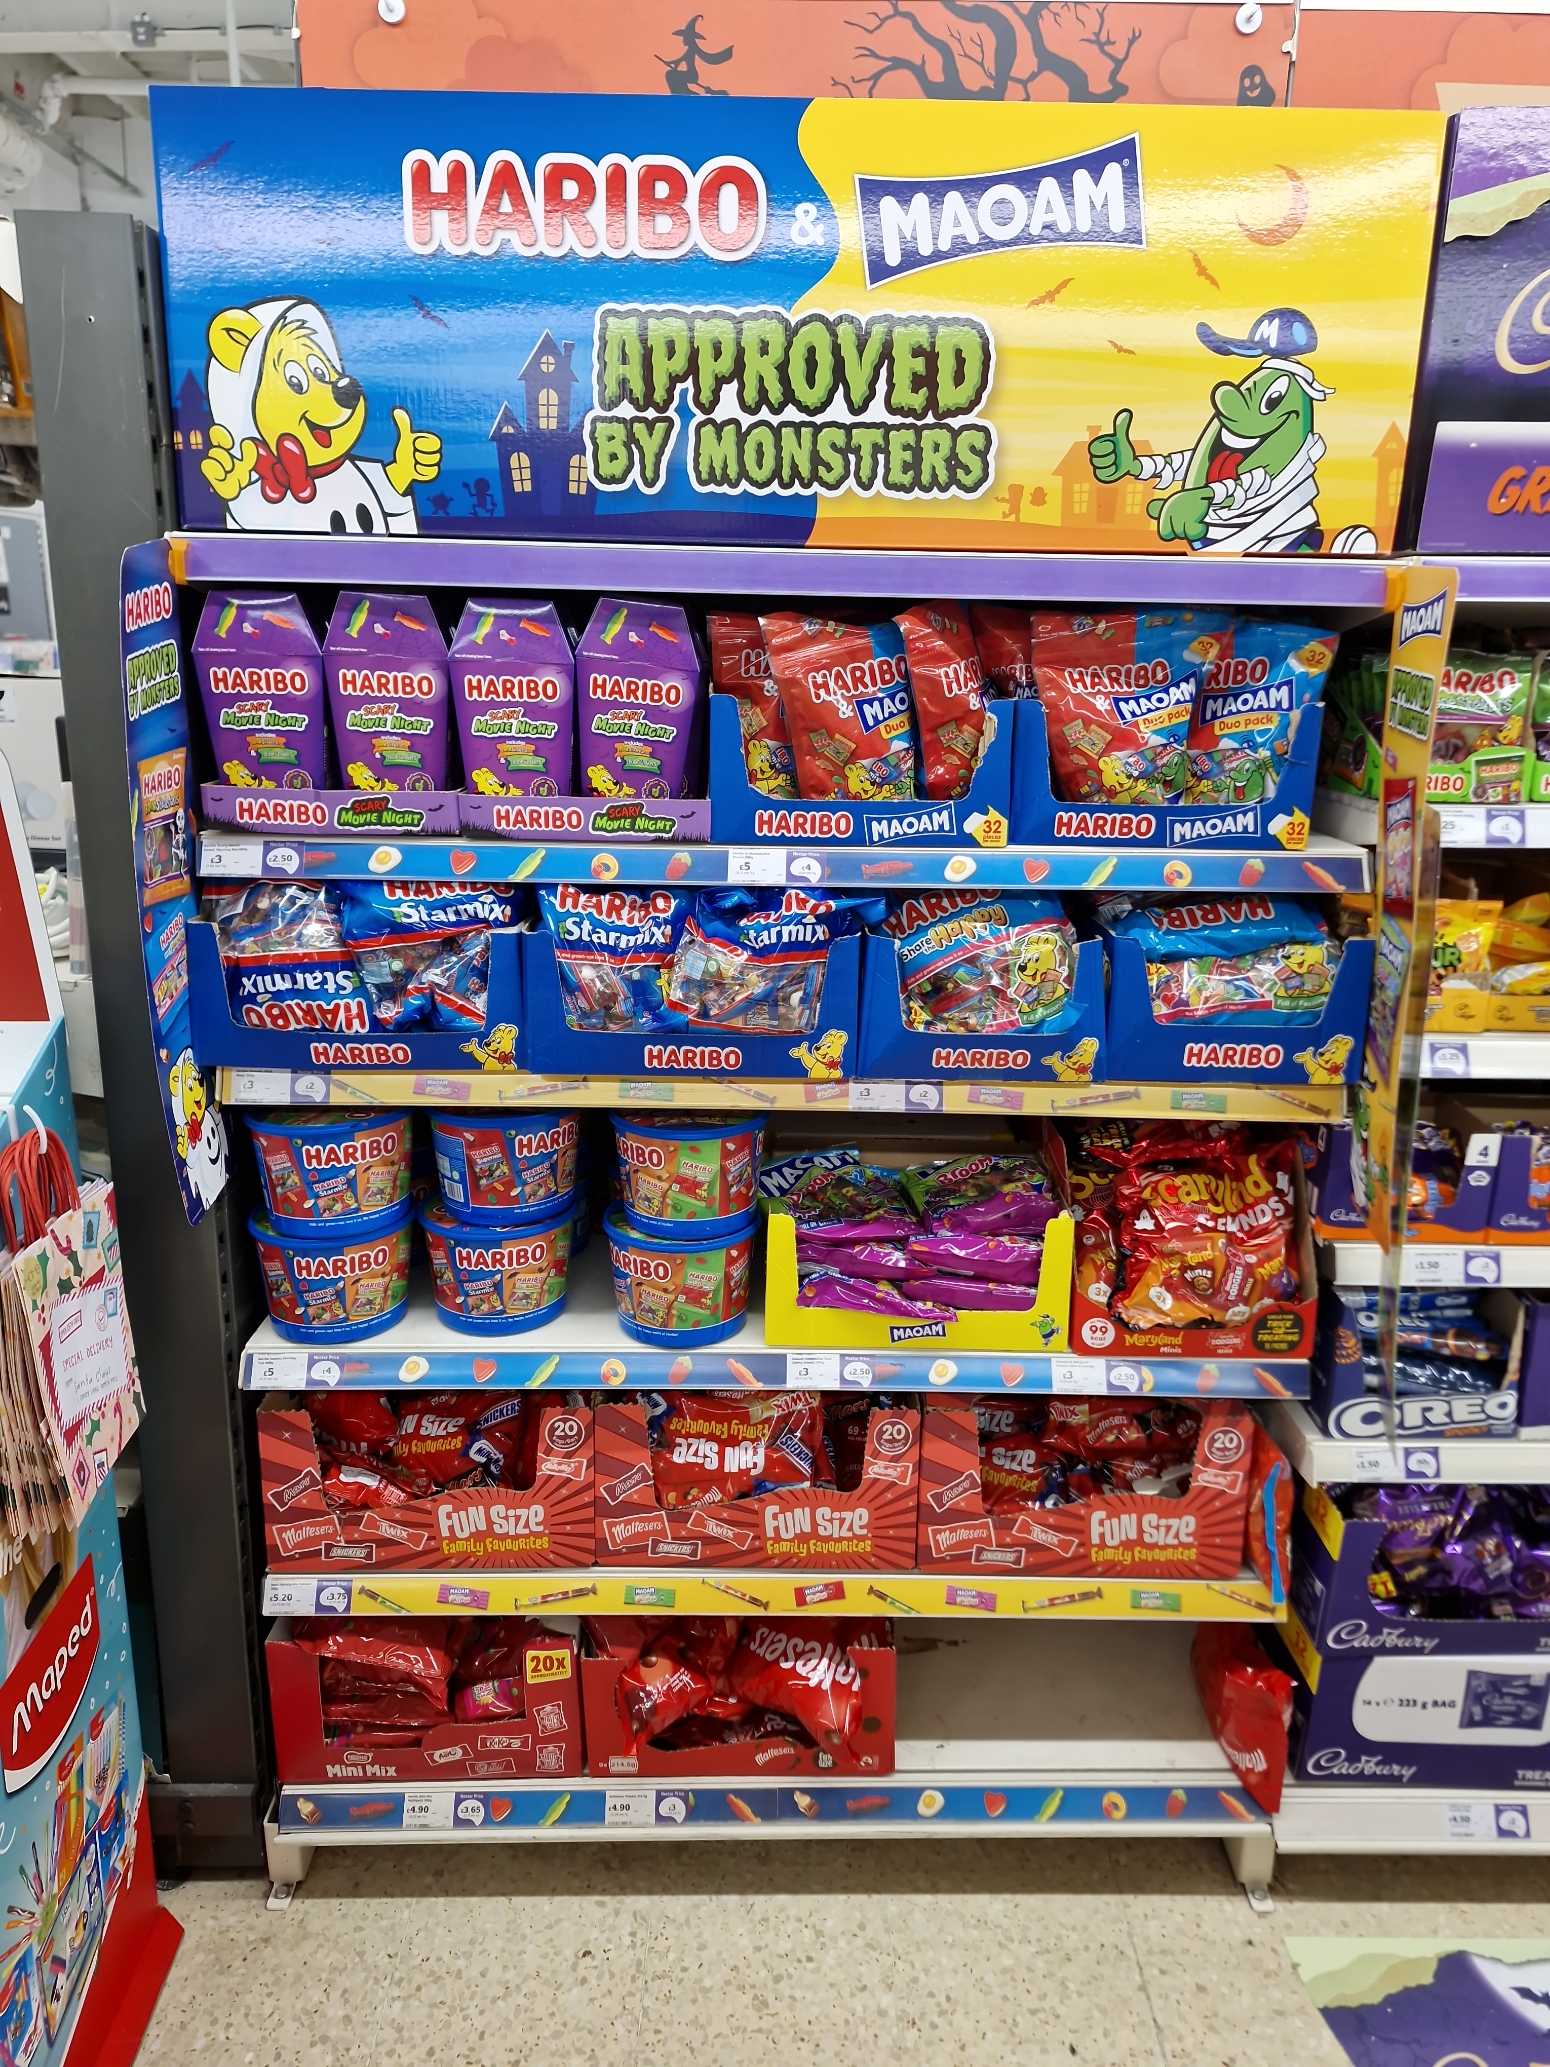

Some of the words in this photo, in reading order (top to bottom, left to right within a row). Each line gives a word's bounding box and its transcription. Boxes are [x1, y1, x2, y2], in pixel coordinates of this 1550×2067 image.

[403, 149, 766, 261] HARIBO
[789, 202, 826, 247] &
[881, 162, 1128, 267] MAOAM
[598, 310, 992, 419] APPROVED
[589, 415, 676, 495] BY
[692, 417, 994, 492] MONSTERS
[125, 581, 173, 632] HARIBO
[1401, 599, 1445, 642] MAOAM
[126, 640, 177, 692] APPROVED
[1306, 650, 1327, 665] 32
[210, 668, 308, 694] HARIBO
[338, 669, 435, 697] HARIBO
[1065, 658, 1171, 694] HARIBO
[1205, 657, 1269, 690] RIBO
[1441, 666, 1517, 695] ARIBO
[140, 674, 180, 713] MONSTERS
[464, 675, 560, 702] HARIBO
[590, 674, 683, 706] HARIBO
[234, 701, 271, 714] SCARY
[969, 693, 980, 711] &
[1119, 678, 1197, 720] MAOAM
[1205, 684, 1292, 721] MAOAM
[362, 704, 398, 716] SCARY
[487, 709, 522, 721] SCARY
[608, 709, 644, 721] SCARY
[838, 701, 854, 719] &
[1167, 706, 1192, 725] pack
[220, 711, 261, 728] MOVIE
[264, 713, 308, 730] NIGHT
[347, 712, 388, 730] MOVIE
[389, 716, 433, 734] NIGHT
[472, 717, 512, 736] MOVIE
[515, 719, 558, 738] NIGHT
[592, 717, 631, 735] MOVIE
[634, 722, 677, 742] NIGHT
[884, 720, 906, 736] Duo
[1219, 716, 1246, 732] Duo
[1248, 713, 1273, 730] pack
[142, 765, 181, 798] HARIBO
[236, 797, 328, 826] HARIBO
[352, 797, 388, 813] SCARY
[607, 804, 641, 819] SCARY
[338, 810, 378, 827] MOVIE
[381, 811, 424, 829] NIGHT
[494, 805, 583, 830] HARIBO
[592, 818, 633, 833] MOVIE
[636, 818, 676, 835] NIGHT
[755, 810, 853, 838] HARIBO
[872, 809, 951, 840] MAOAM
[983, 819, 1002, 834] 32
[1055, 812, 1156, 840] HARIBO
[1173, 812, 1254, 844] MAOAM
[1286, 821, 1305, 836] 32
[211, 854, 223, 864] £3
[268, 854, 293, 863] £2.50
[739, 861, 751, 871] £5
[400, 896, 506, 923] Starmix
[160, 911, 184, 949] HARIBO
[565, 916, 666, 948] Starmix
[928, 904, 1009, 949] Happy
[901, 936, 932, 962] Share
[241, 970, 354, 997] Starmix
[242, 999, 370, 1034] HARIBO
[310, 1042, 411, 1065] HARIBO
[644, 1045, 742, 1070] HARIBO
[932, 1048, 1030, 1069] HARIBO
[1184, 1043, 1284, 1068] HARIBO
[860, 1088, 870, 1097] £3
[919, 1090, 929, 1098] £2
[516, 1122, 577, 1158] HARIB
[303, 1132, 397, 1169] HARIBO
[471, 1147, 500, 1159] HARIBO
[1478, 1146, 1489, 1160] 4
[682, 1160, 713, 1173] HARIBO
[313, 1177, 346, 1191] HARIBO
[318, 1184, 348, 1197] Starmix
[294, 1246, 389, 1279] HARIBO
[456, 1242, 546, 1271] HARIBO
[464, 1280, 494, 1290] HARIBO
[688, 1272, 719, 1282] HARIBO
[304, 1288, 336, 1300] HARIBO
[641, 1288, 669, 1302] HARIBO
[892, 1323, 943, 1340] MAOAM
[1089, 1325, 1108, 1335] 99
[1124, 1333, 1184, 1347] Maryland
[1160, 1346, 1182, 1354] Minis
[263, 1367, 274, 1377] £5
[798, 1368, 809, 1377] £3
[849, 1367, 871, 1377] £2.50
[1062, 1370, 1074, 1380] £3
[1113, 1372, 1135, 1382] £2.50
[1330, 1390, 1518, 1438] OREO
[554, 1420, 578, 1436] 20
[882, 1424, 906, 1439] 20
[1213, 1432, 1236, 1449] 20
[673, 1437, 719, 1470] Size
[723, 1441, 766, 1476] FUN
[437, 1505, 487, 1538] FUN
[490, 1505, 545, 1535] Size
[765, 1505, 810, 1539] FUN
[815, 1507, 870, 1538] Size
[1090, 1511, 1138, 1547] FUN
[1142, 1514, 1196, 1543] Size
[281, 1525, 335, 1548] Maltesers
[611, 1522, 662, 1541] Maltesers
[936, 1527, 988, 1549] Maltesers
[442, 1539, 484, 1556] Family
[486, 1535, 551, 1553] Favourites
[766, 1540, 807, 1556] Family
[809, 1539, 871, 1555] Favourites
[1091, 1548, 1132, 1565] Family
[1134, 1548, 1196, 1563] Favourites
[270, 1594, 293, 1604] £5.20
[326, 1593, 348, 1602] £3.75
[1326, 1620, 1440, 1653] Cadbury
[530, 1655, 567, 1673] 20x
[11, 1606, 95, 1756] Maped
[755, 1747, 795, 1767] Maltesers
[1307, 1749, 1417, 1782] Cadbury
[326, 1764, 367, 1777] Mini
[369, 1765, 398, 1777] Mix
[406, 1805, 430, 1815] £4.90
[460, 1806, 481, 1815] £3.65
[608, 1804, 631, 1812] £4.90
[668, 1804, 677, 1812] £3
